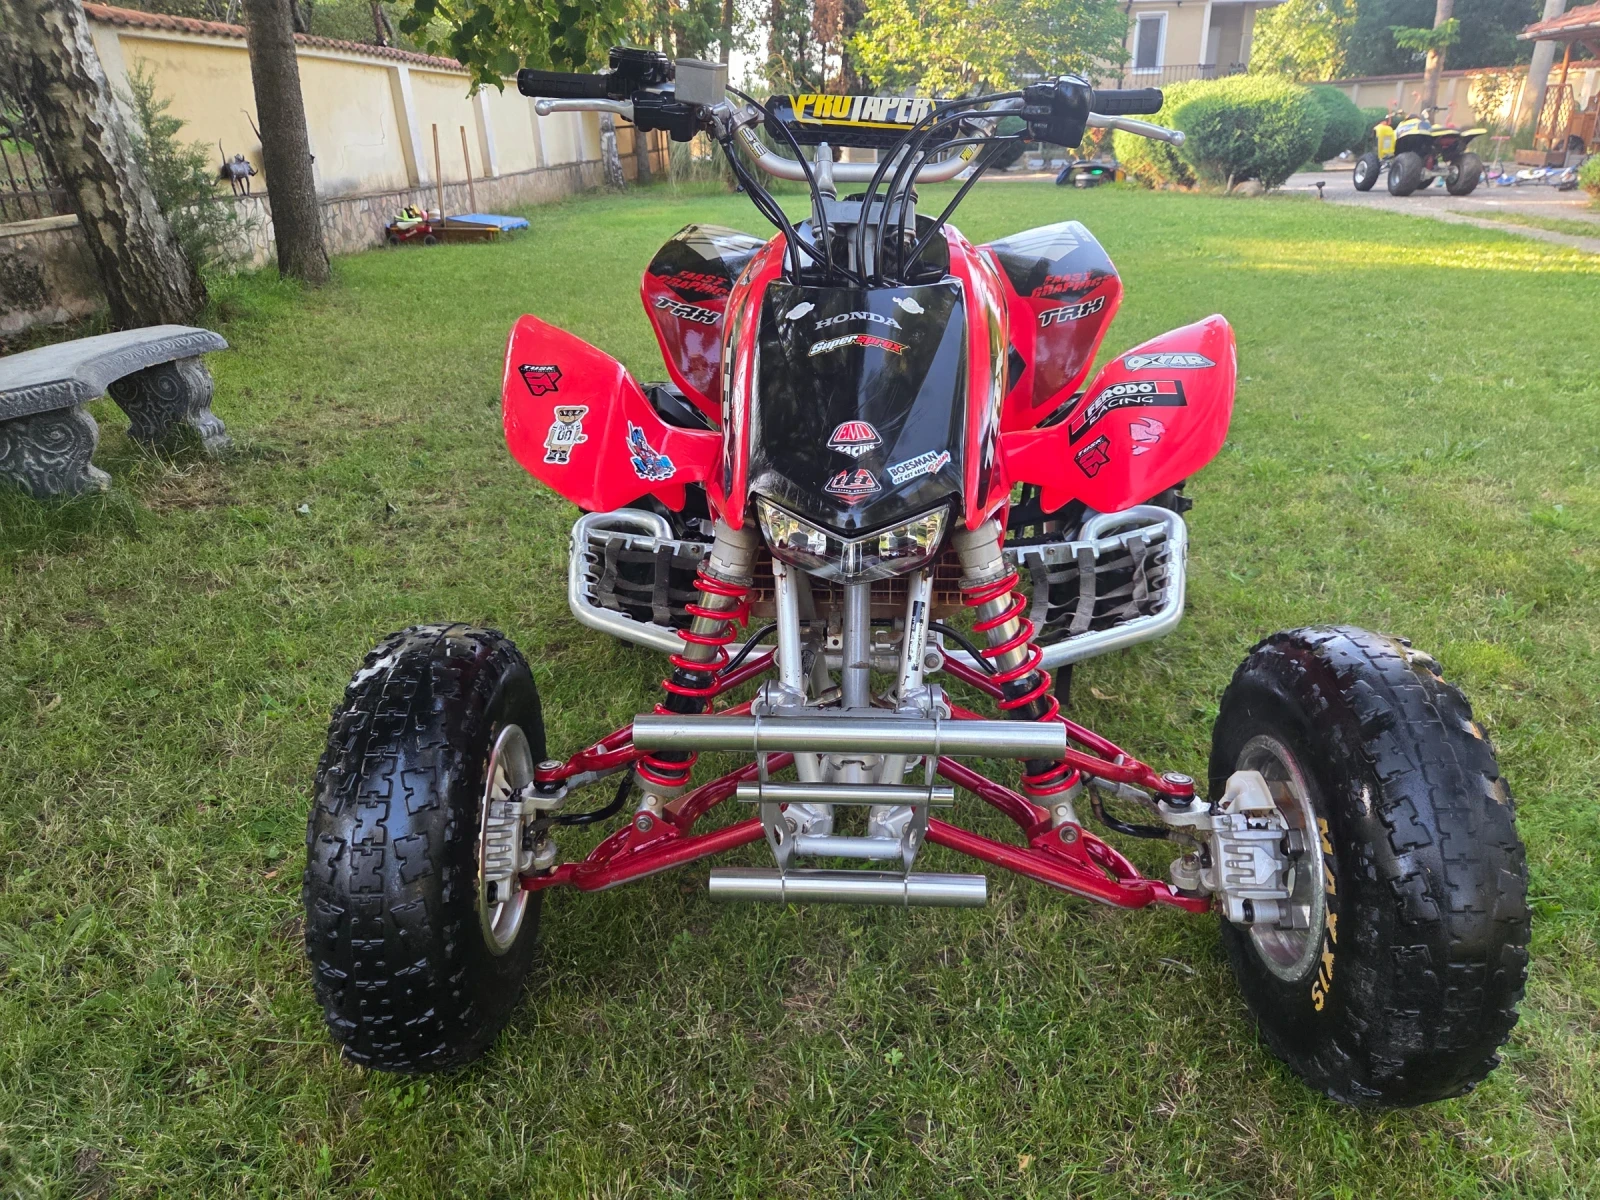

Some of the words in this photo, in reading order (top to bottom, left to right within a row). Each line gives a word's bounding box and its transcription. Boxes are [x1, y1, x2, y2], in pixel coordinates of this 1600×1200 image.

[656, 296, 722, 325] TRX
[814, 311, 903, 331] HONDA
[1038, 296, 1105, 327] TRX
[1086, 382, 1155, 418] FERODO
[1089, 395, 1154, 426] RACING
[835, 443, 875, 457] RACING
[889, 452, 939, 477] BOESMAN
